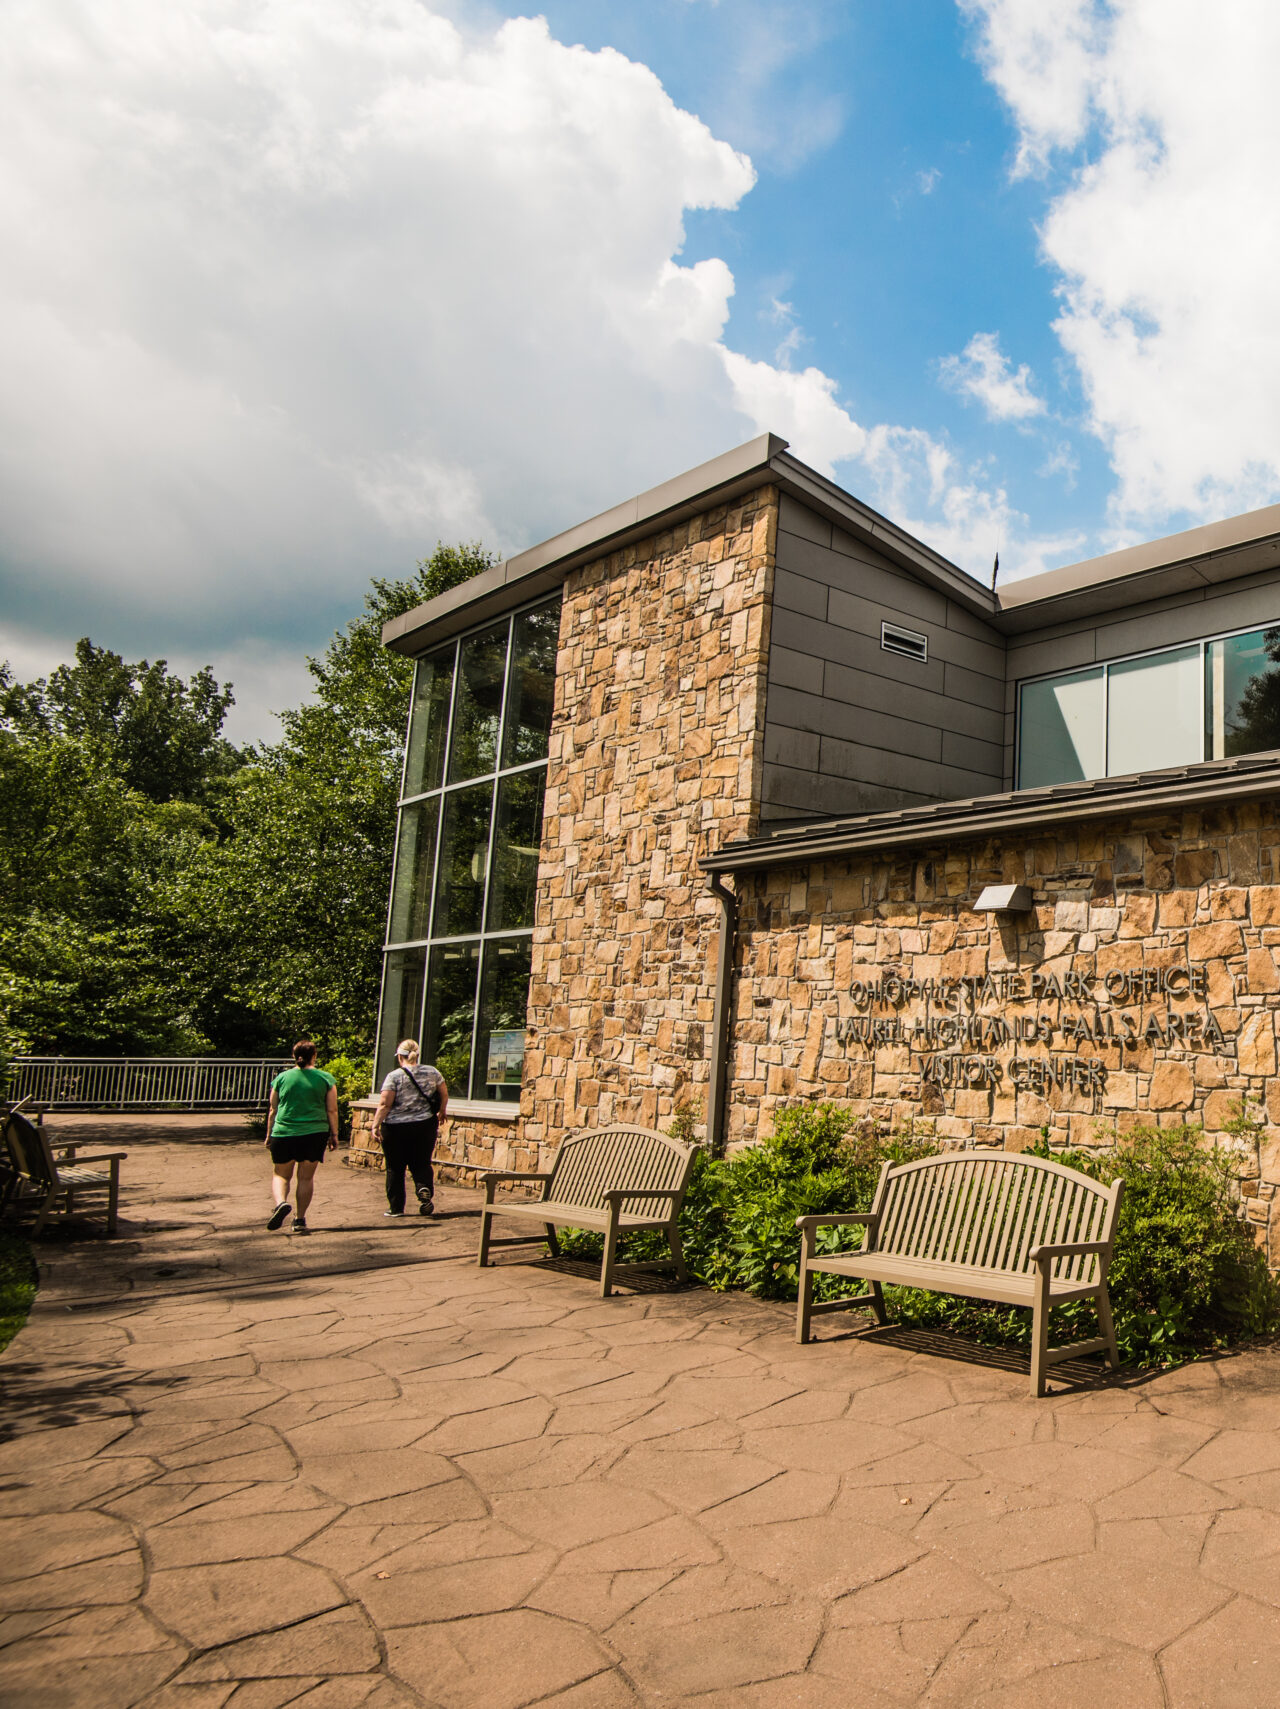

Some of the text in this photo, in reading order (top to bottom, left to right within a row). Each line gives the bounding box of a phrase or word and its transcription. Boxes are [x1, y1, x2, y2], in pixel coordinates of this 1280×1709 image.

[848, 965, 1207, 1004] OHIOPYLE STATE PARK OFFICE
[833, 1010, 1224, 1043] LAUREL HIGHLANDS FALLS AREA
[916, 1055, 1103, 1085] VISITOR CENTER
